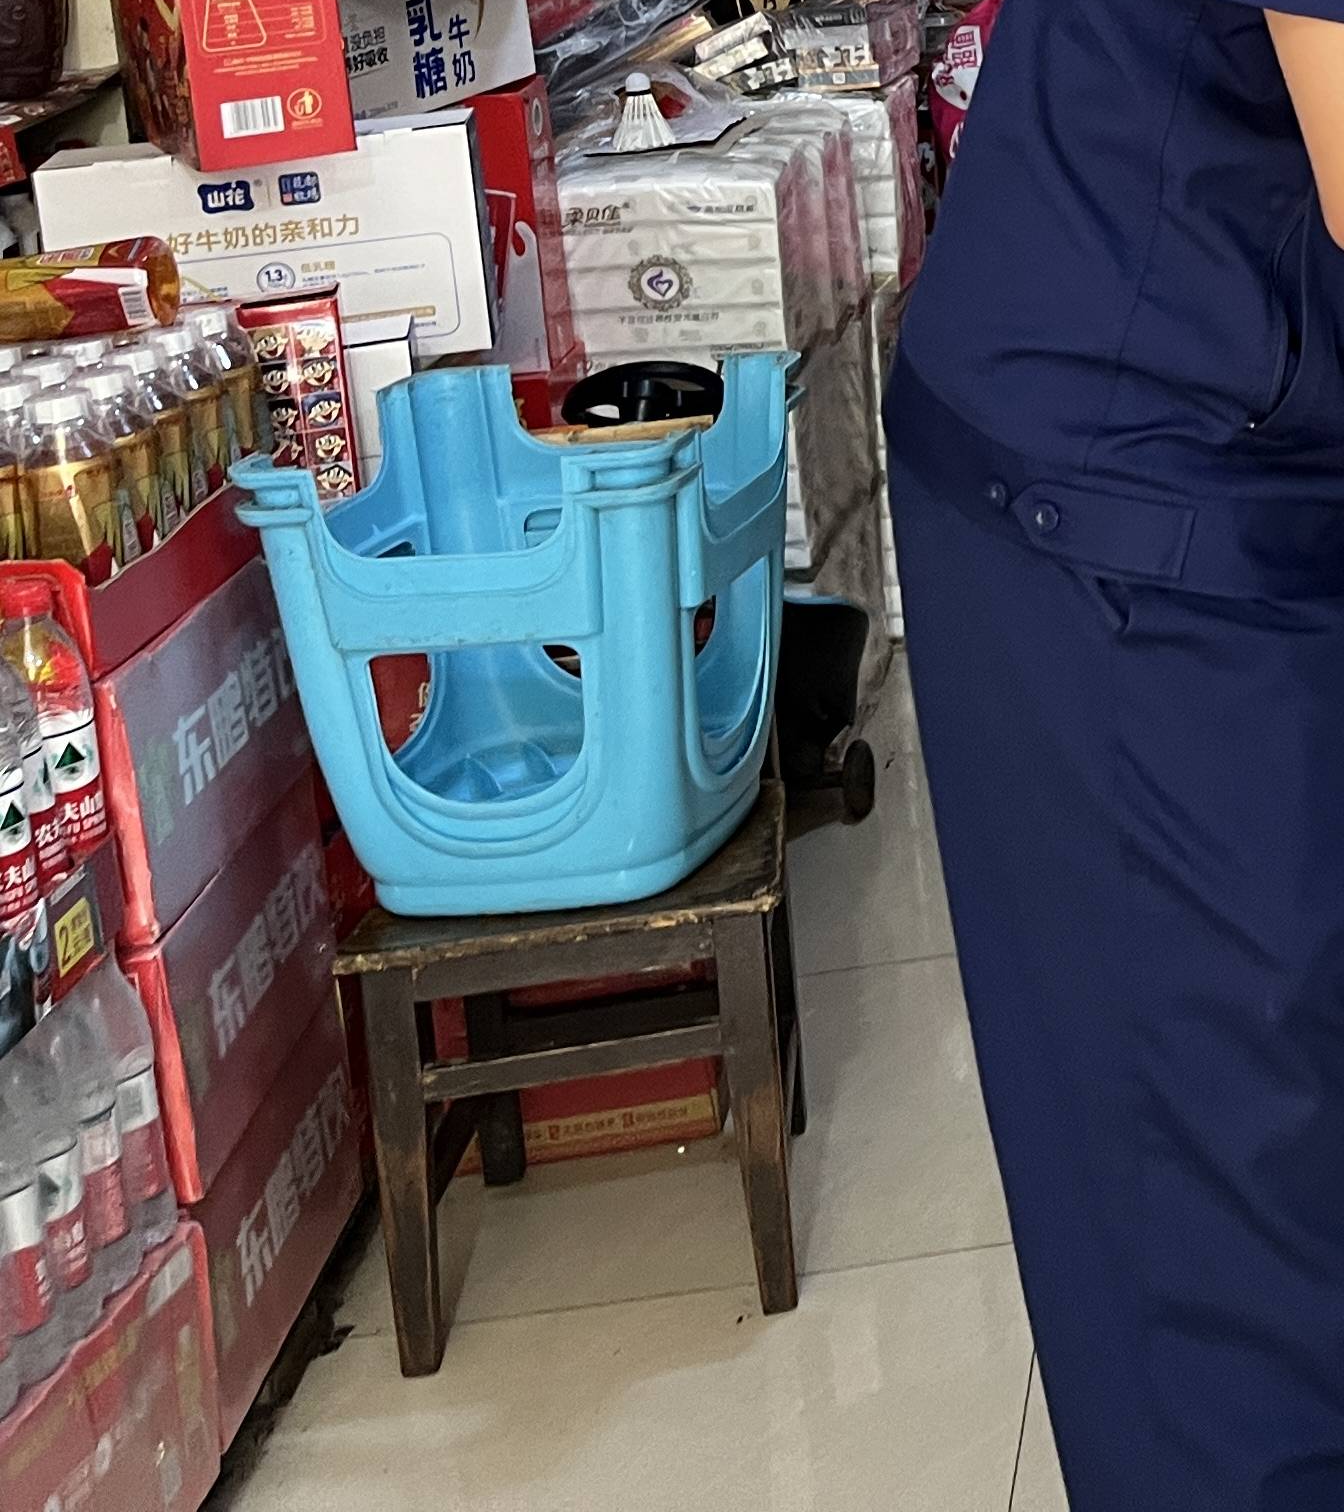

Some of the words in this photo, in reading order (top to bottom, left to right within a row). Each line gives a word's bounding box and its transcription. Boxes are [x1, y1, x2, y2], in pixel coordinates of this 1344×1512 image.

[448, 14, 476, 87] 牛奶
[168, 215, 360, 256] 好牛奶的亲和力
